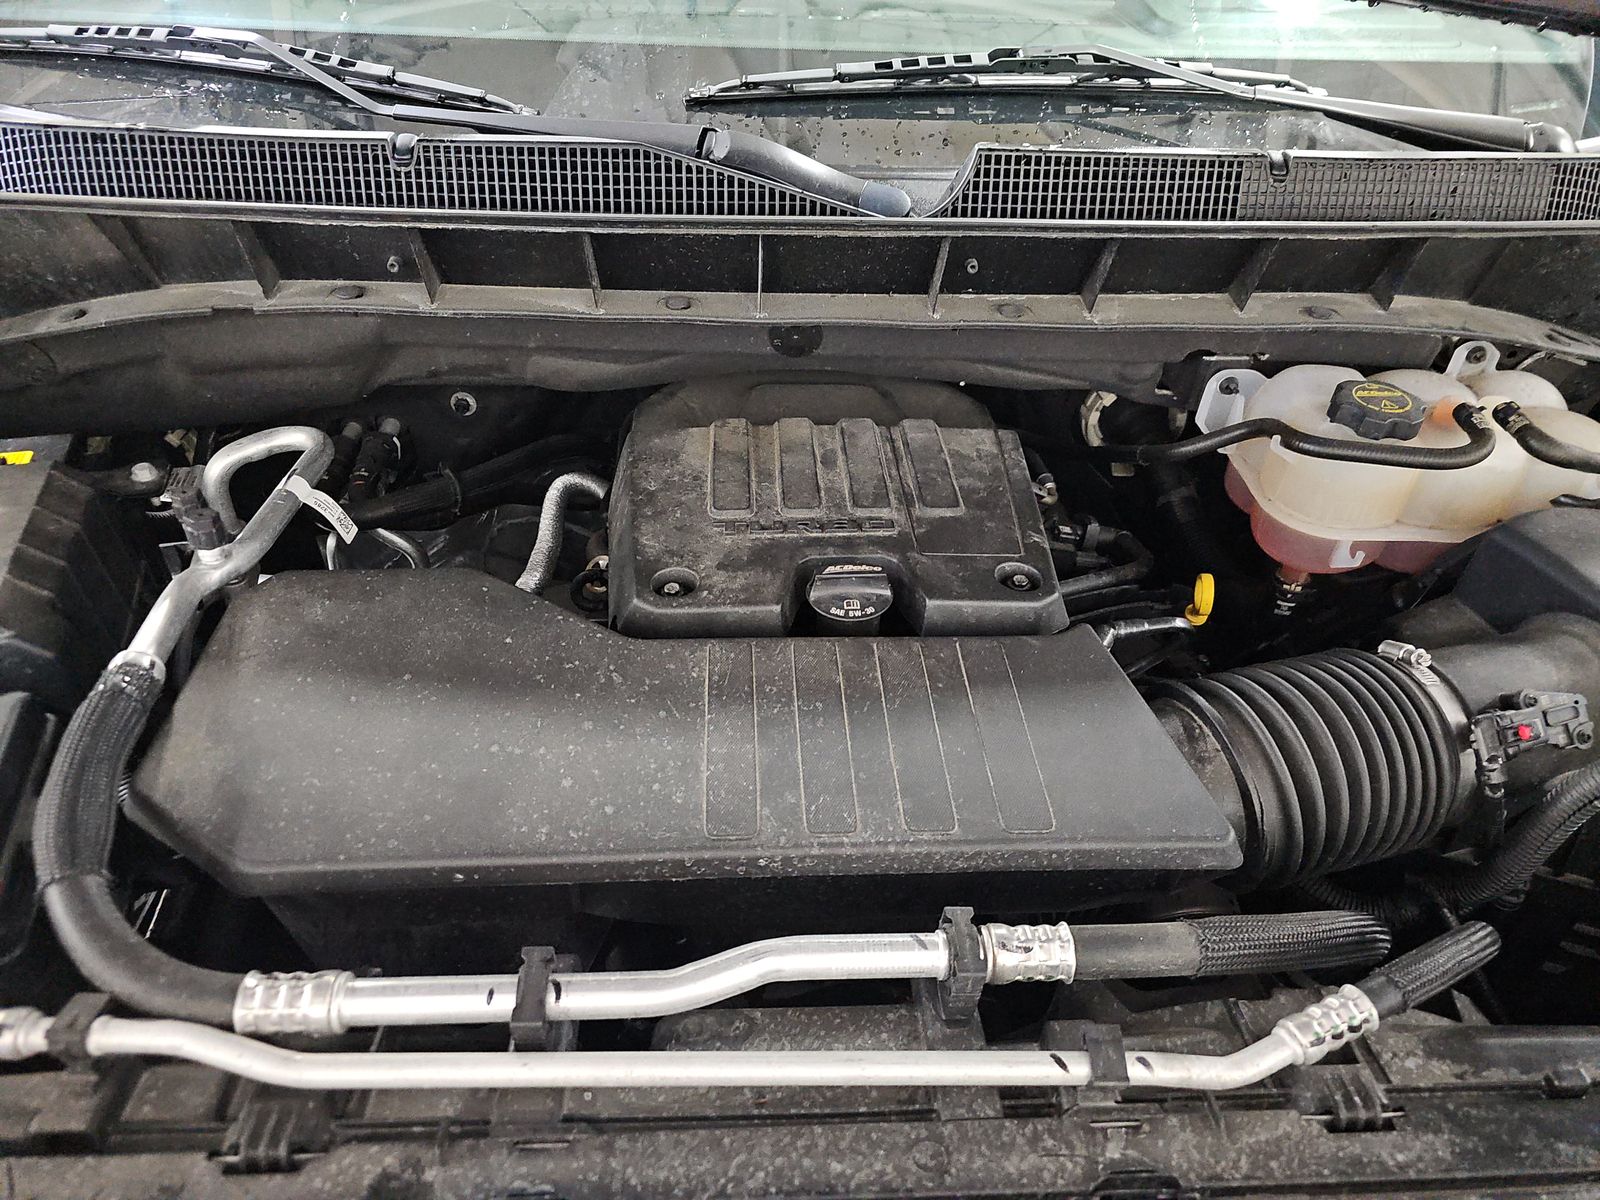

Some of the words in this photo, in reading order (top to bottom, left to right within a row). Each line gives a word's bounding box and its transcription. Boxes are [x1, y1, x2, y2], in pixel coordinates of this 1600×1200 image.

[712, 520, 897, 537] TURBO
[822, 564, 882, 574] ACDelco
[830, 606, 845, 616] SAE
[848, 606, 875, 617] 5W-30
